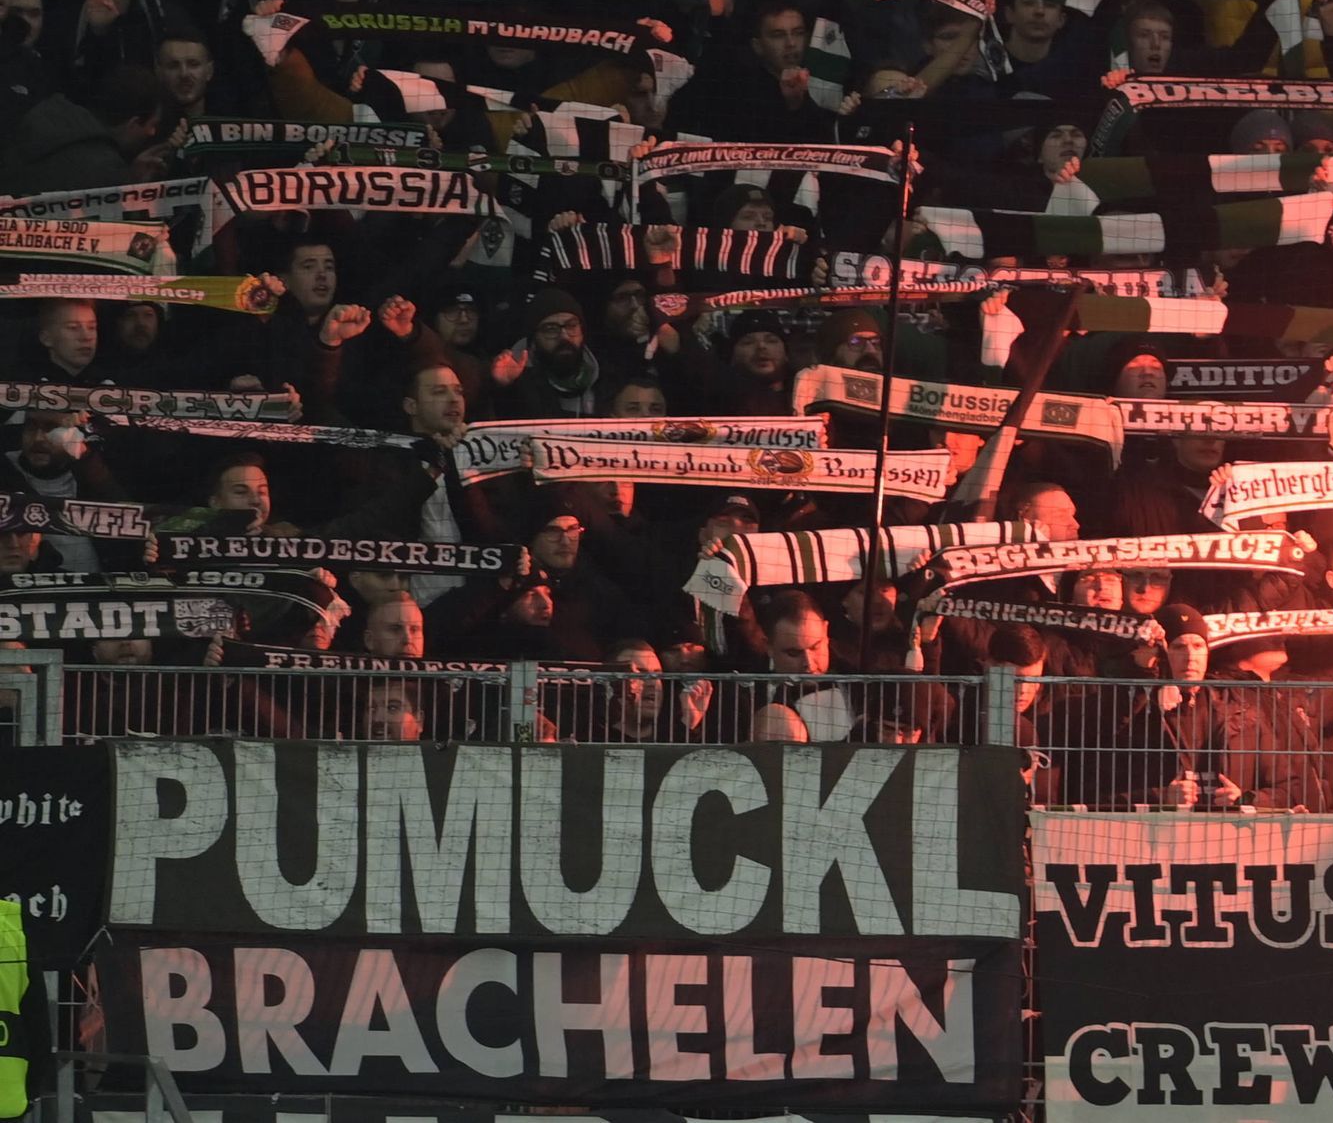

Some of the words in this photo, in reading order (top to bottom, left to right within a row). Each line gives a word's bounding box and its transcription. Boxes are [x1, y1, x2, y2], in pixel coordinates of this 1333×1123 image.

[321, 13, 463, 35] BORUSSIA
[220, 123, 274, 142] BIN
[285, 124, 425, 148] BORUSSE
[249, 170, 469, 210] BORUSSIA
[24, 220, 50, 232] VFL
[87, 386, 271, 422] CREW
[908, 384, 1012, 414] Borussia
[67, 501, 150, 540] VFL
[170, 535, 503, 570] FREUNDESKREIS
[942, 532, 1283, 577] BEGLEITSERVICE
[11, 572, 90, 588] SEIT
[186, 571, 265, 588] 1900
[108, 744, 1020, 938] PUMUCKL
[138, 946, 977, 1083] BRACHELEN
